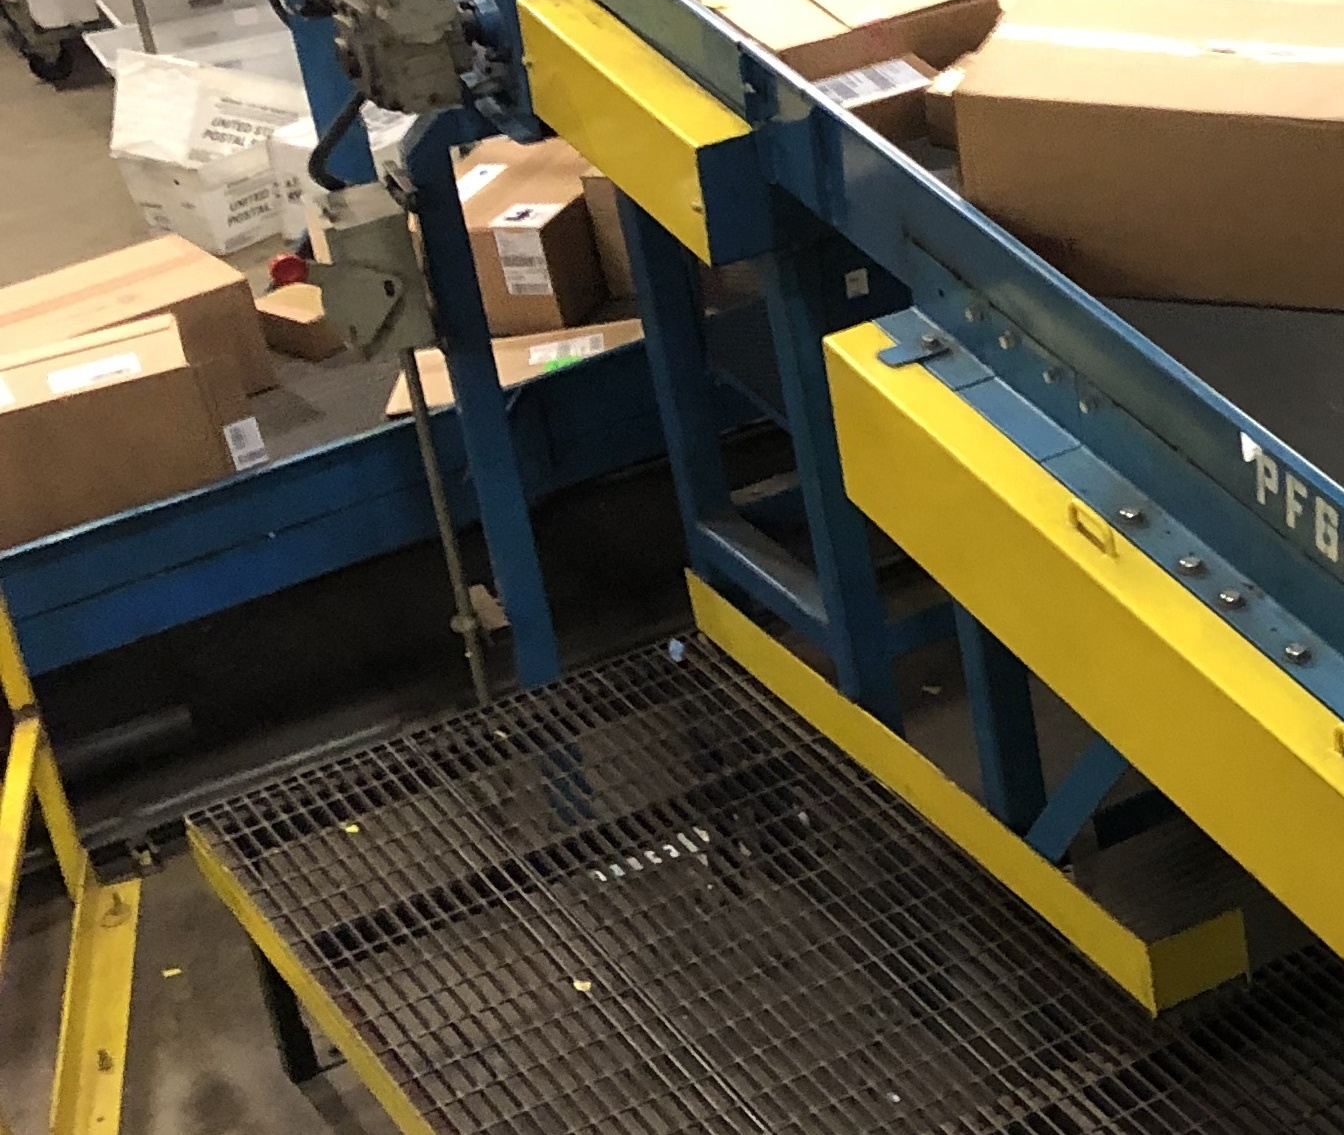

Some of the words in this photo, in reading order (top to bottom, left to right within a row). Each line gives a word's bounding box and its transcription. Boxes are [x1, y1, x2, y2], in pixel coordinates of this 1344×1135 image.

[210, 117, 253, 134] UNITED
[202, 128, 246, 147] POSTAL
[228, 188, 270, 212] UNITED
[226, 203, 271, 228] POSTAL
